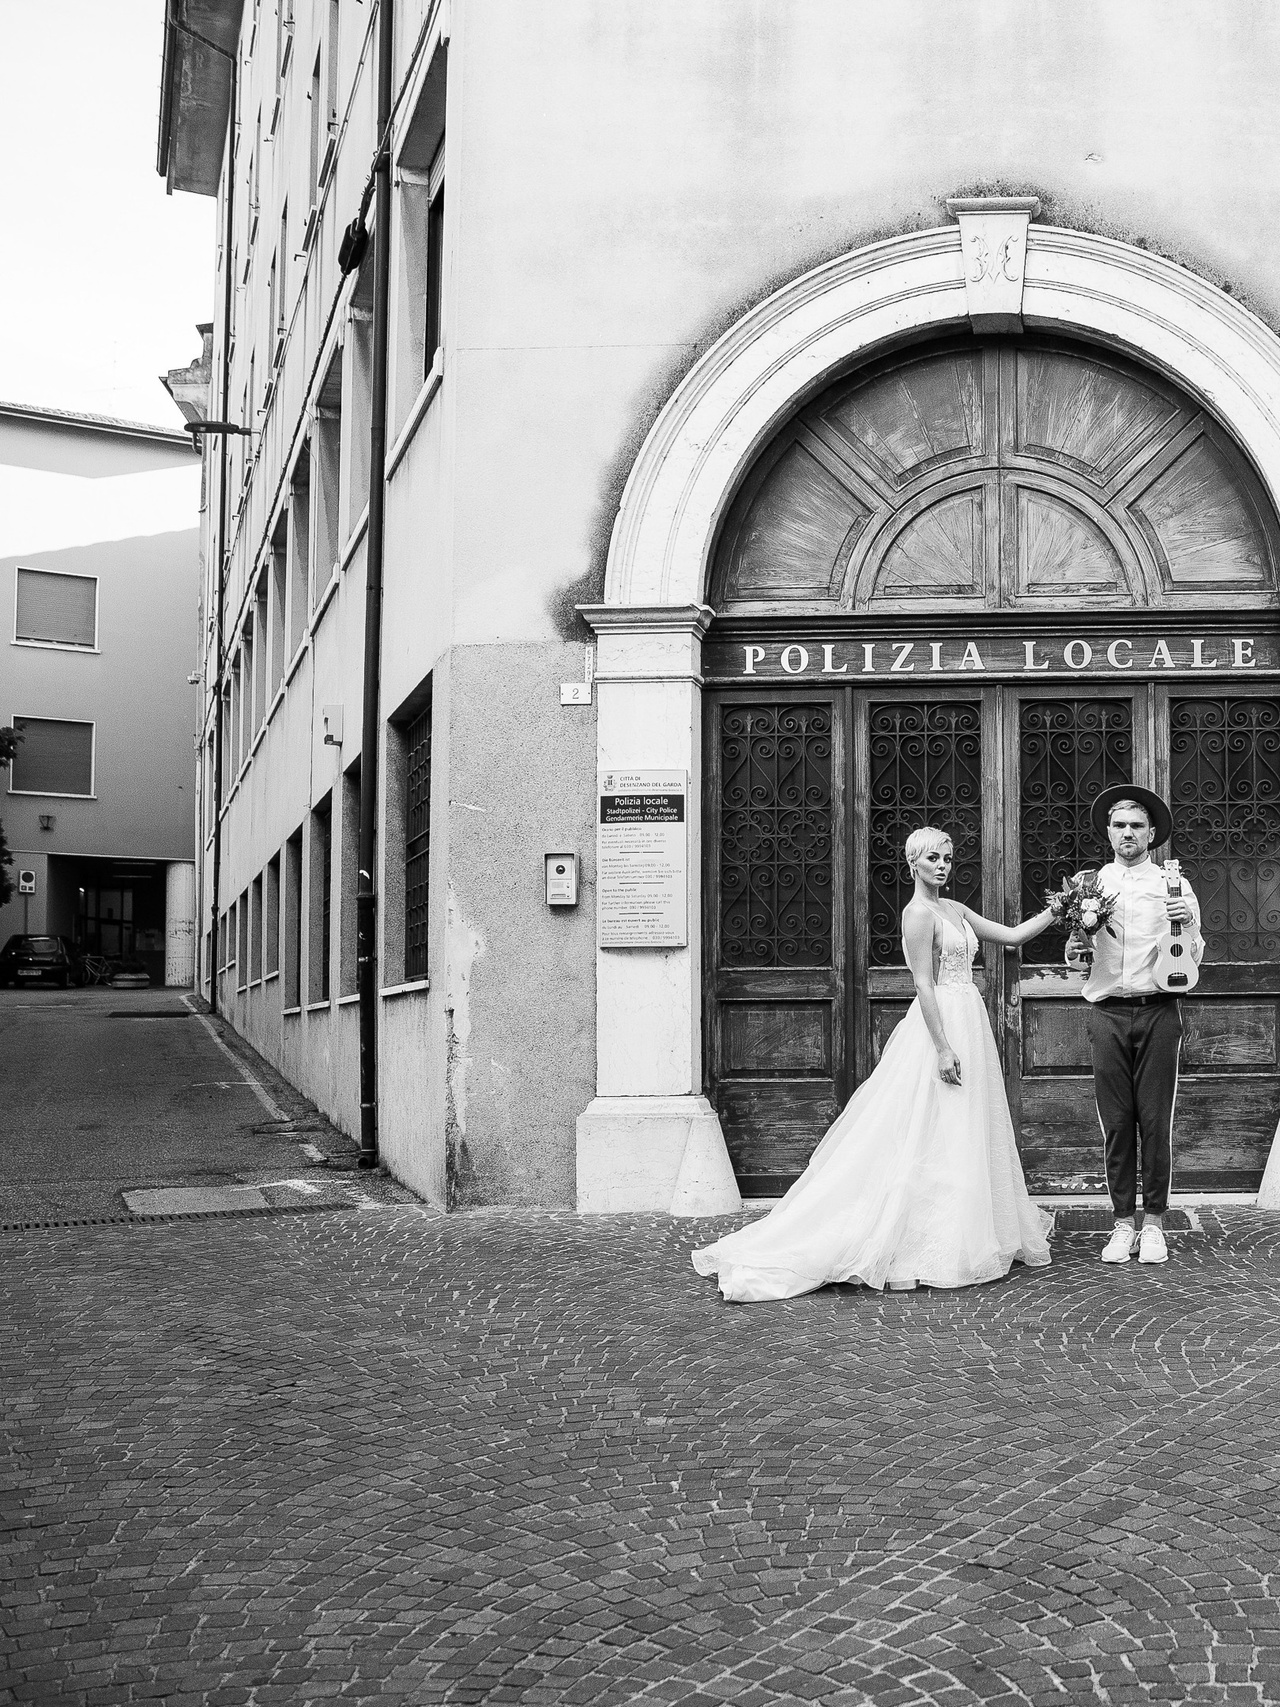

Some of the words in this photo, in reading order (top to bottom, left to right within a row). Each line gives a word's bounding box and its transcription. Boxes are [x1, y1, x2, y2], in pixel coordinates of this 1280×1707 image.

[743, 642, 986, 674] POLIZIA
[1022, 638, 1257, 670] LOCALE
[572, 688, 579, 699] 2
[614, 796, 641, 806] Polizia
[643, 796, 669, 805] locale
[606, 807, 641, 815] Stadtpolizei
[646, 807, 659, 815] City
[644, 814, 679, 822] Municipale
